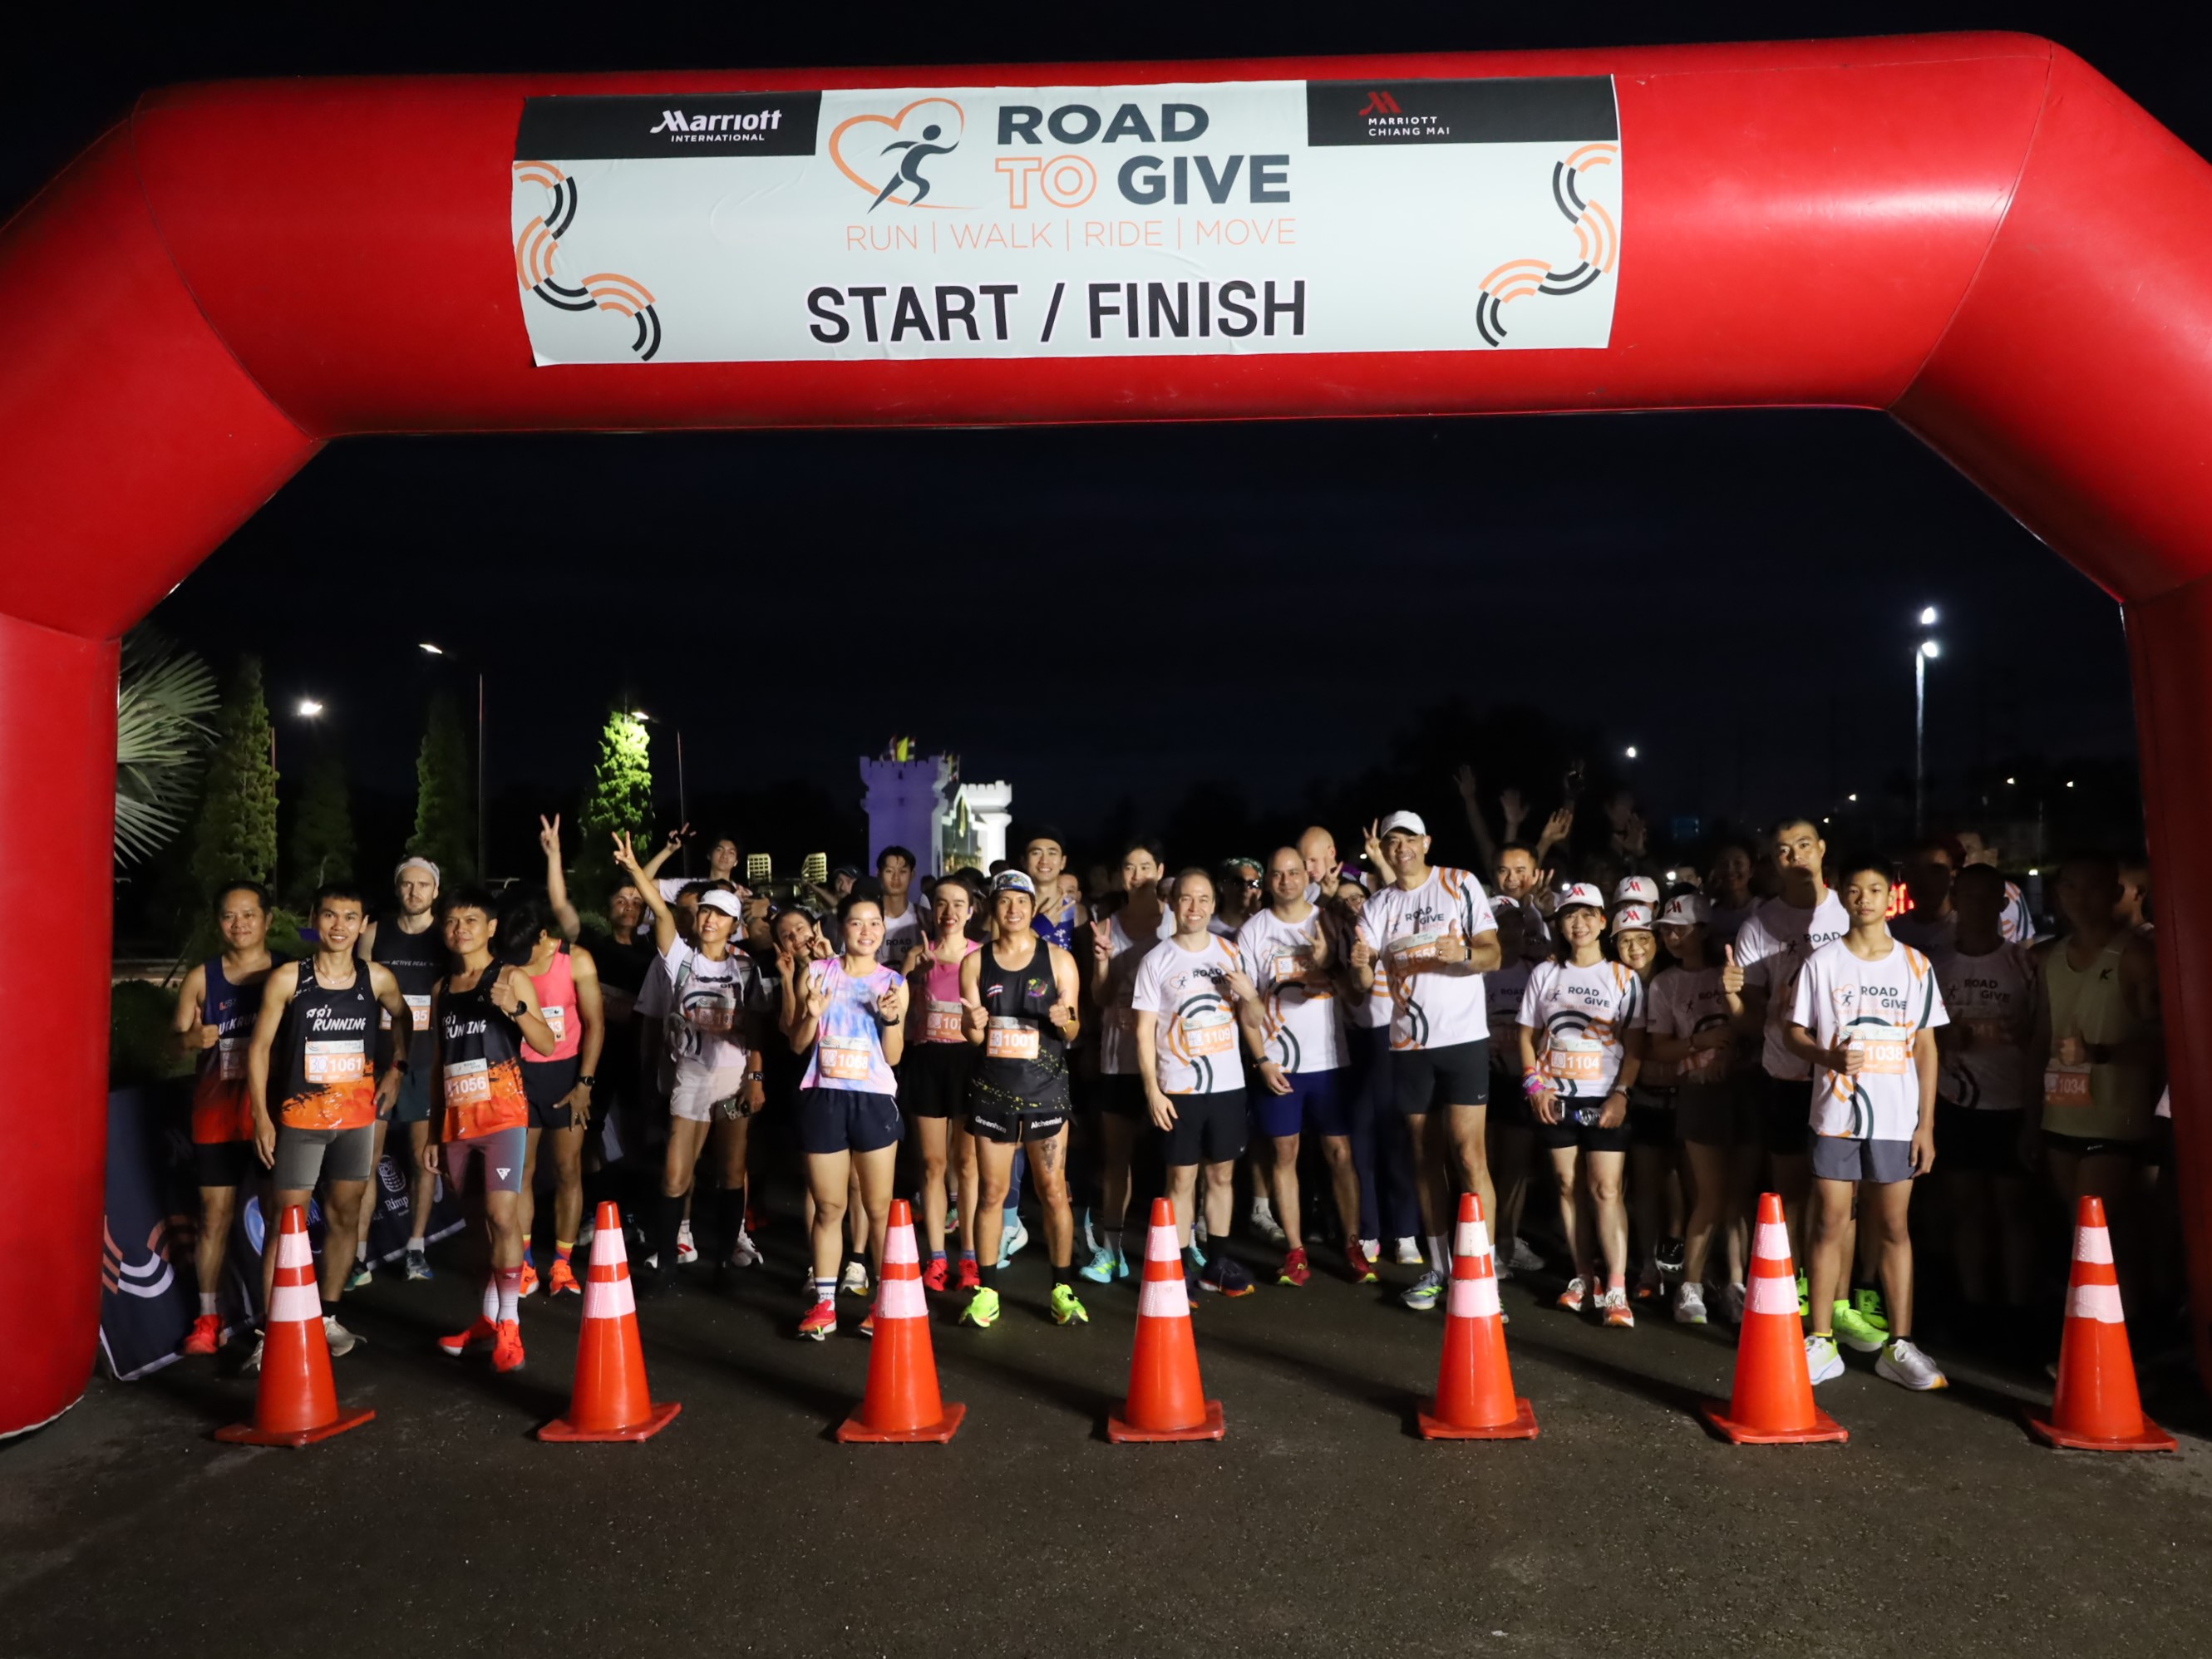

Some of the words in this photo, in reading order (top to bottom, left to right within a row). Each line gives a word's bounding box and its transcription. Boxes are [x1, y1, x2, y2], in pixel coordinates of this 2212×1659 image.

[649, 109, 782, 134] Marriott
[998, 102, 1209, 145] ROAD
[1368, 116, 1437, 126] MARRIOTT
[671, 133, 765, 142] INTERNATIONAL
[1368, 127, 1421, 136] CHIANG
[1426, 126, 1450, 135] MAI
[995, 153, 1097, 209] TO
[1117, 154, 1291, 205] GIVE
[846, 224, 918, 251] RUN
[949, 221, 1052, 250] WALK
[1085, 219, 1164, 248] RIDE
[1196, 218, 1297, 246] MOVE
[806, 283, 1018, 344] START
[1088, 279, 1306, 340] FINISH
[1406, 906, 1432, 922] ROAD
[1420, 913, 1445, 925] GIVE
[1803, 932, 1841, 943] ROAD
[1191, 967, 1224, 979] ROAD
[1964, 978, 1998, 989] ROAD
[1568, 987, 1600, 997] ROAD
[1860, 986, 1899, 997] ROAD
[1980, 989, 2011, 1003] GIVE
[1584, 997, 1610, 1008] GIVE
[1880, 998, 1907, 1010] GIVE
[312, 1017, 367, 1031] RUNNING
[1003, 1033, 1036, 1047] 1001
[1203, 1027, 1231, 1044] 1109
[1867, 1045, 1904, 1061] 1038
[328, 1057, 363, 1073] 1061
[838, 1054, 869, 1069] 1068
[1566, 1056, 1600, 1070] 1104
[453, 1076, 487, 1095] 1056
[2058, 1078, 2086, 1095] 1034
[974, 1115, 1007, 1135] Greenhorn
[1030, 1116, 1062, 1130] Alchemist
